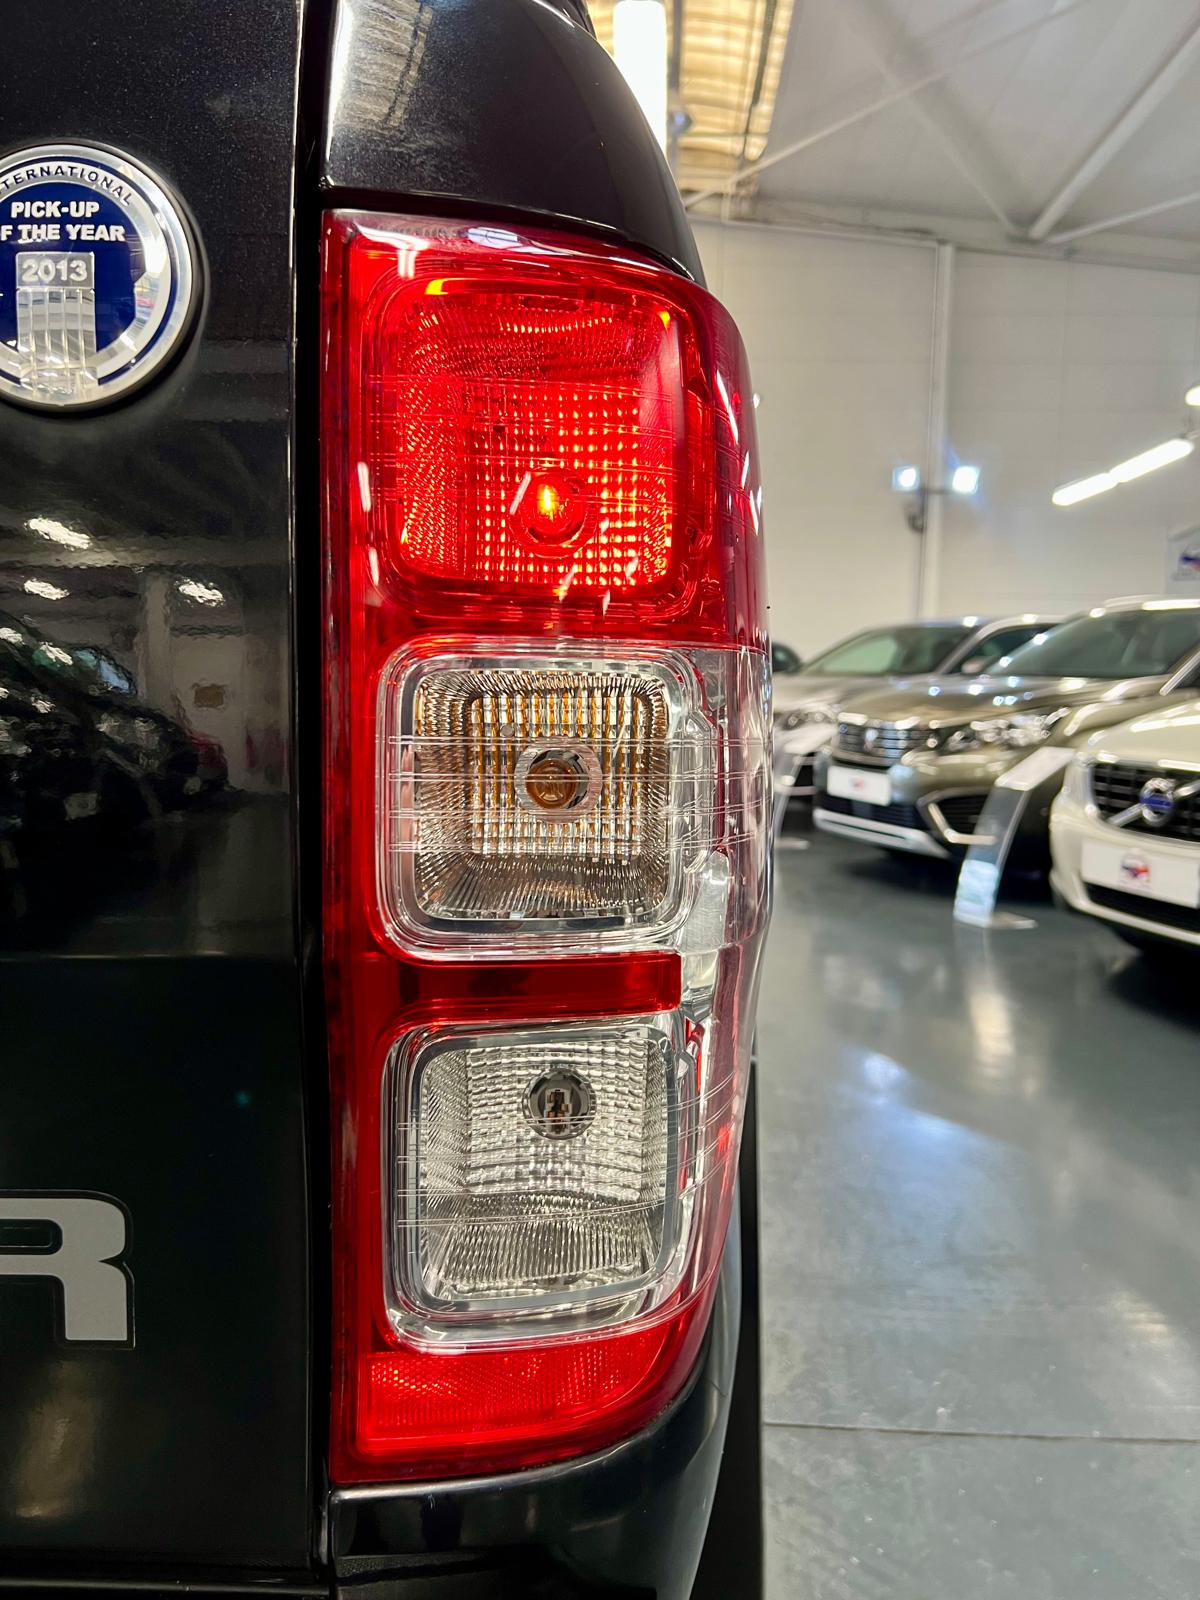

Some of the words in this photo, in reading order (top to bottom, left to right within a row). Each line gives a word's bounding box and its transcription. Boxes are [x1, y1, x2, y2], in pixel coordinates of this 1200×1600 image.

[0, 165, 132, 206] TERNATIONAL
[11, 201, 100, 218] PICK-UP
[18, 224, 61, 241] THE
[66, 224, 126, 241] YEAR
[22, 259, 88, 283] 2013
